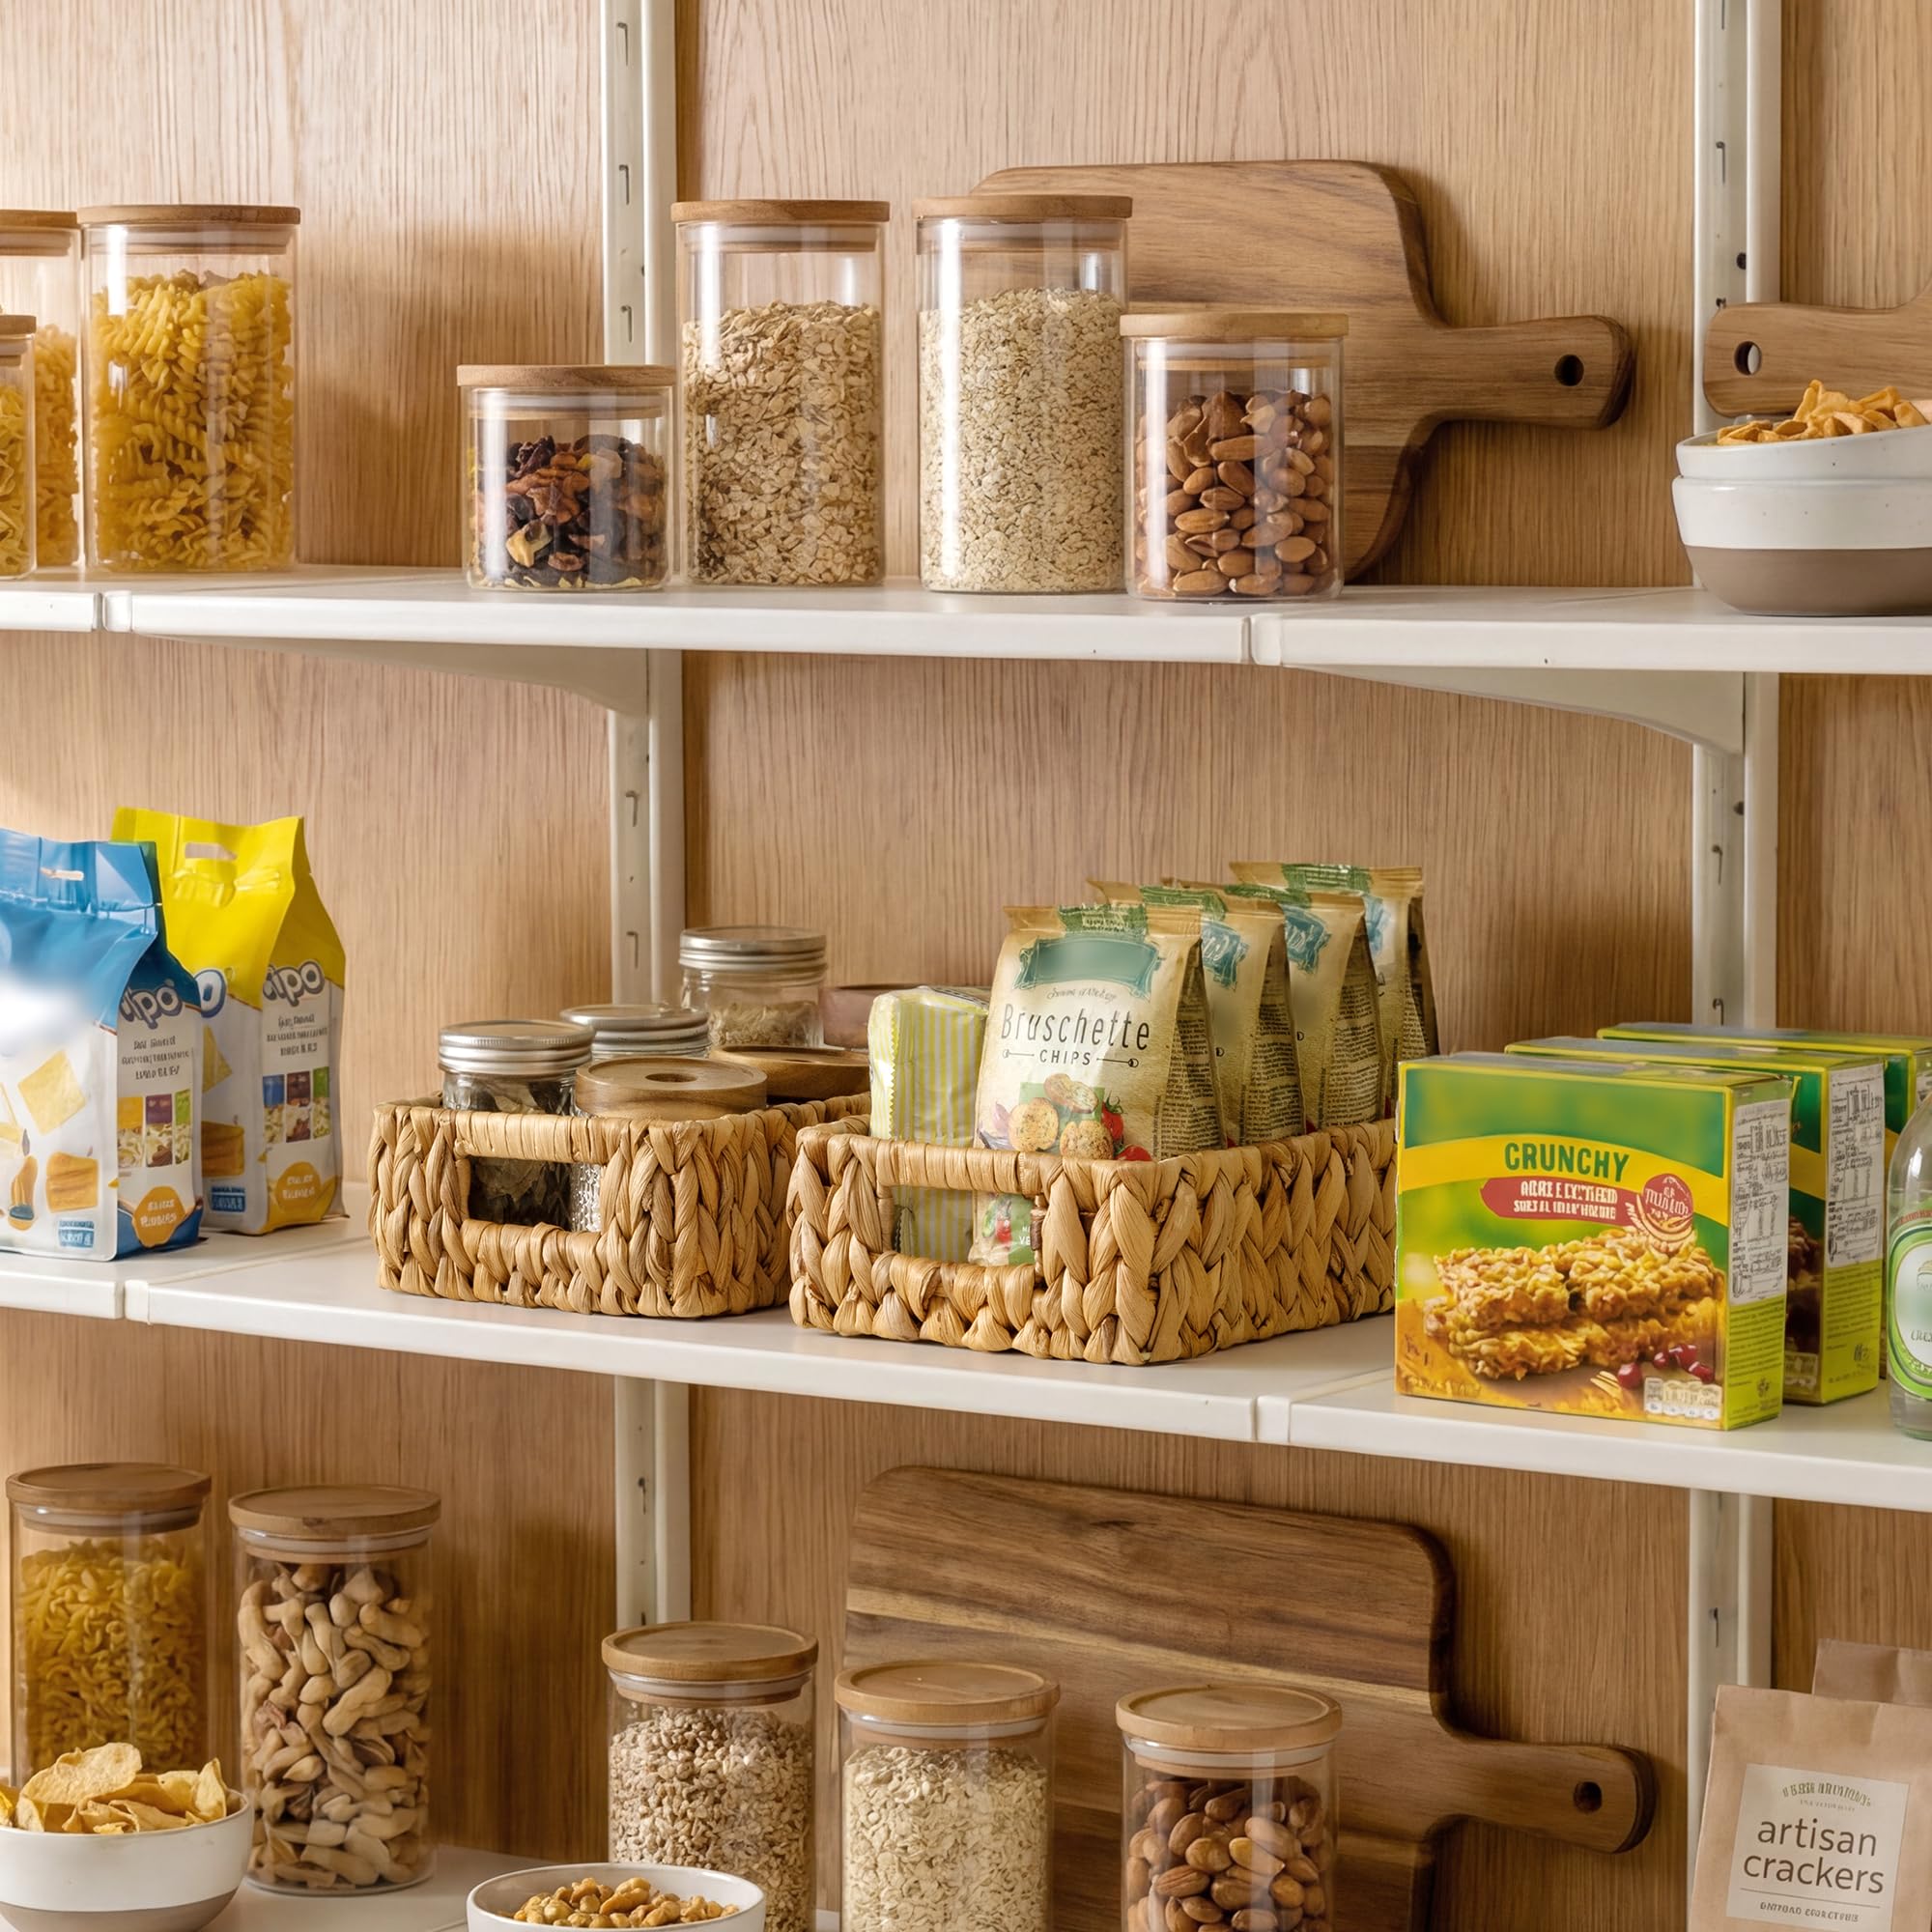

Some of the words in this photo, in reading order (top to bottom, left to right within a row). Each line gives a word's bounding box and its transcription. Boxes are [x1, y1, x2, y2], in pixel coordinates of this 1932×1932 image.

[1001, 1004, 1150, 1050] Bruschette
[1039, 1049, 1091, 1065] CHIPS
[1504, 1142, 1630, 1182] CRUNCHY
[1757, 1818, 1877, 1857] artisan
[1743, 1855, 1885, 1894] crackers
